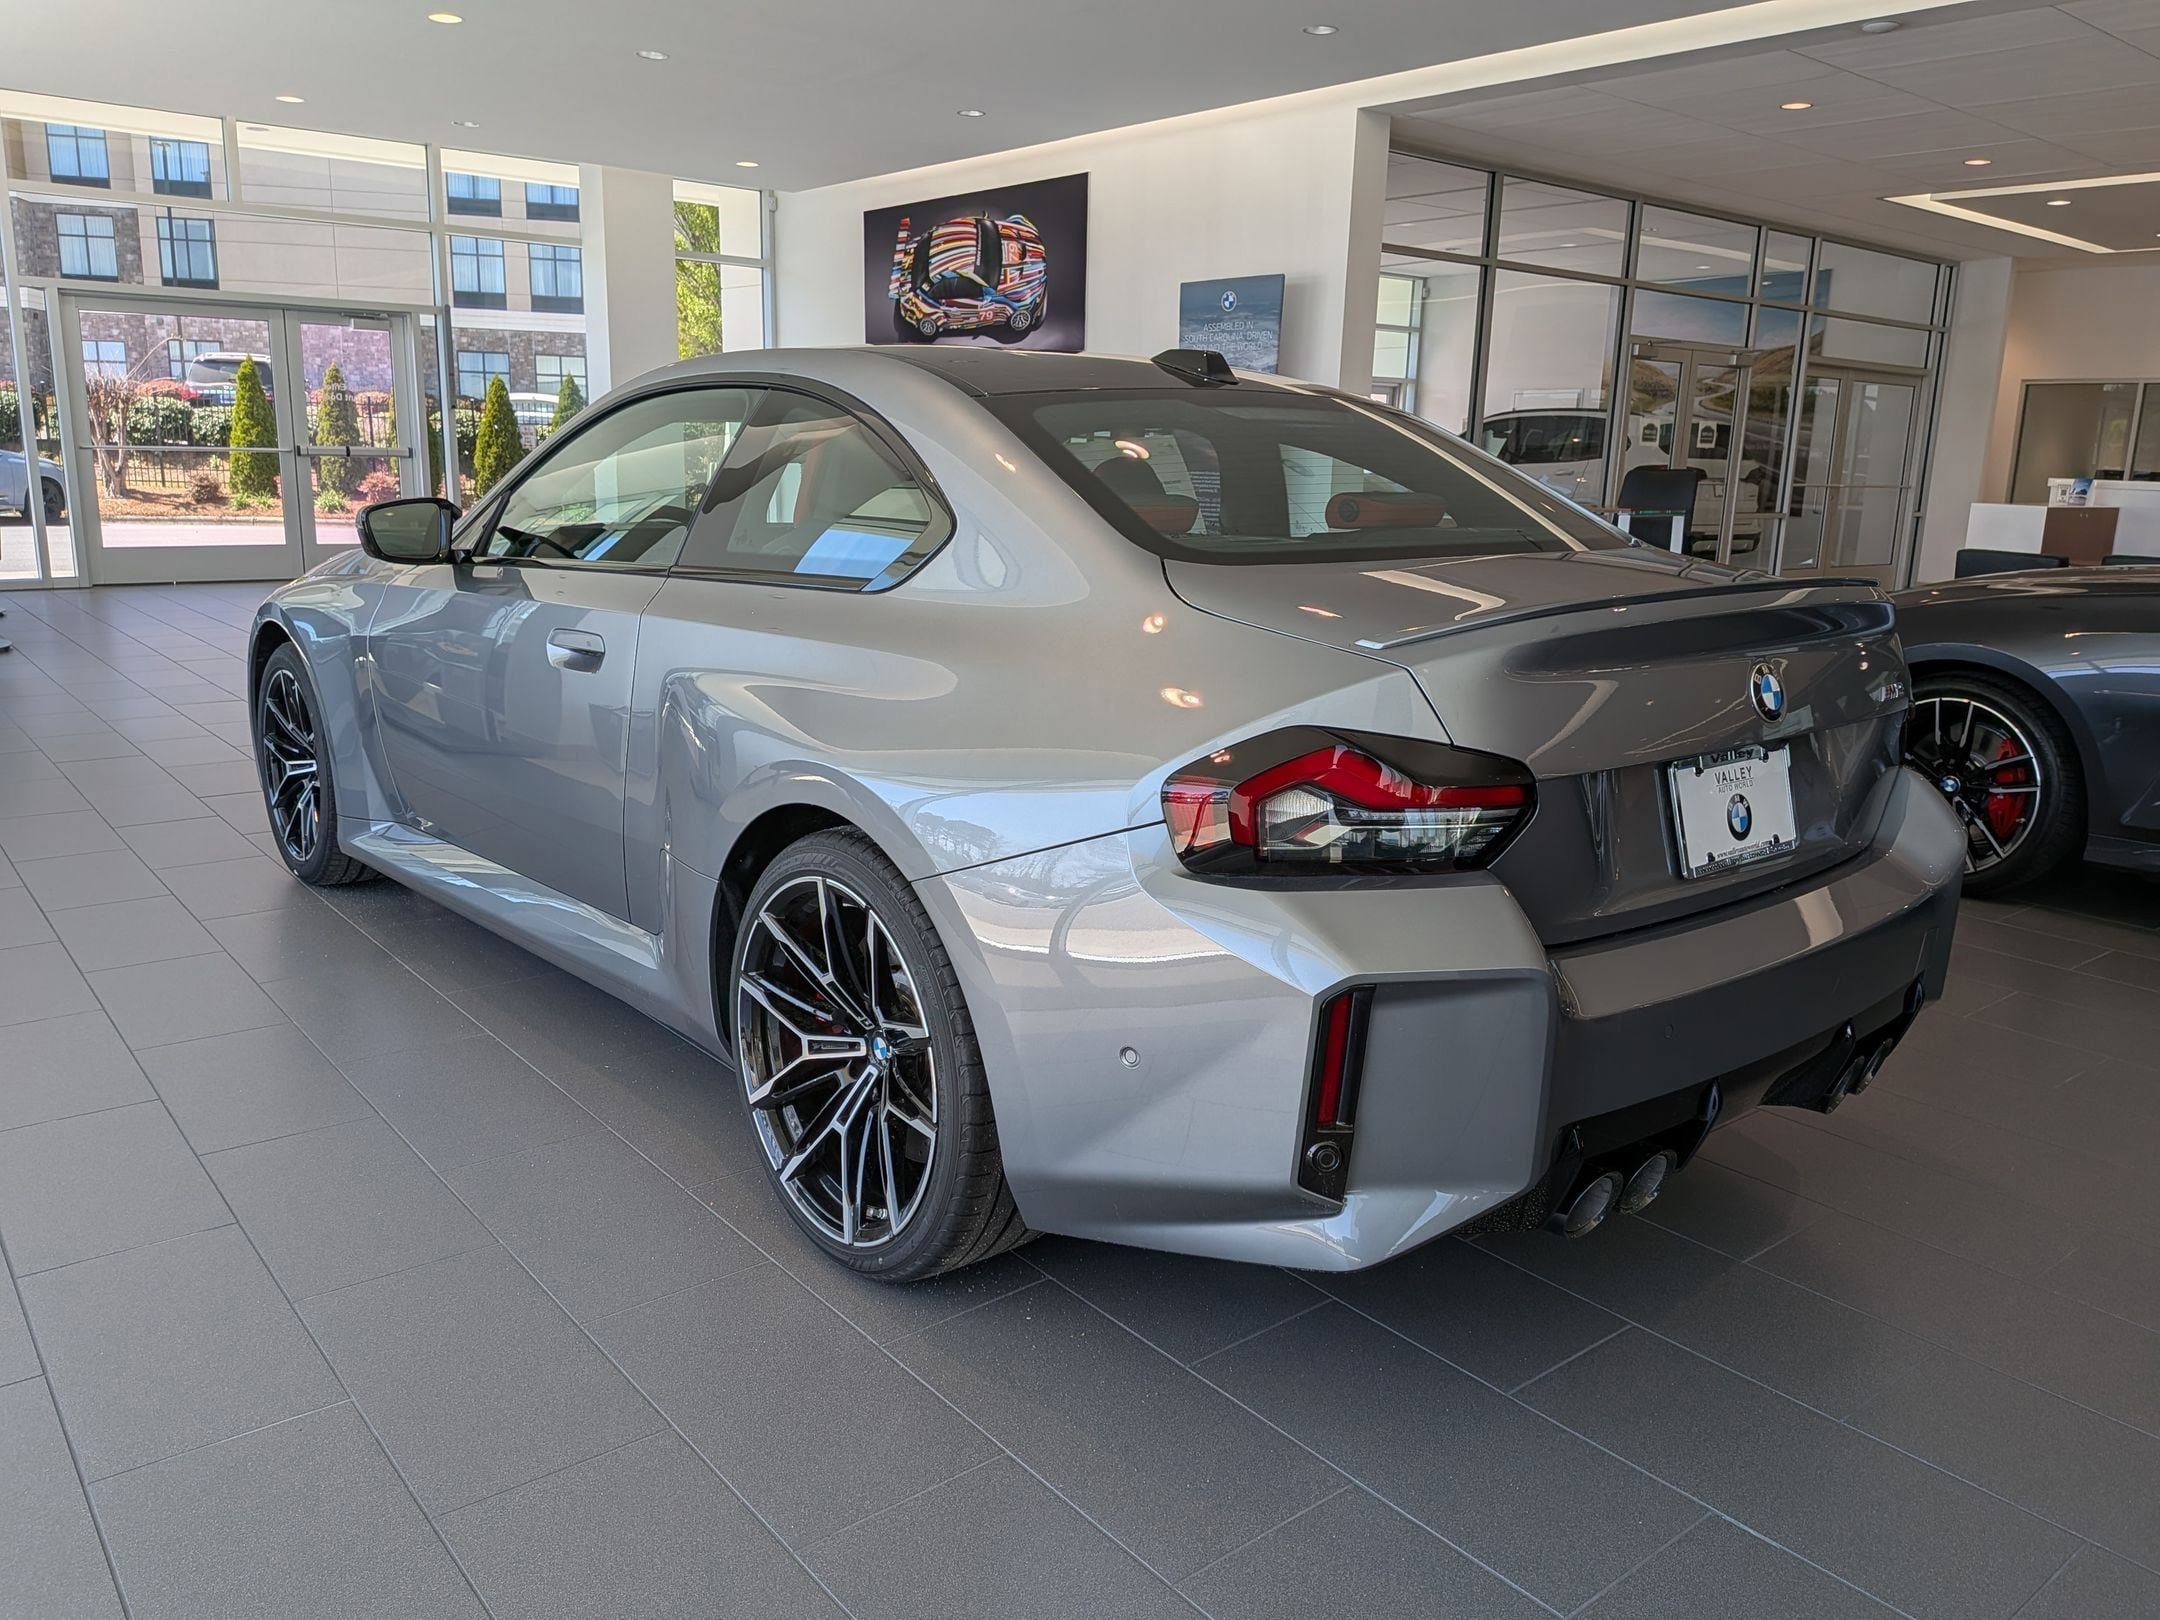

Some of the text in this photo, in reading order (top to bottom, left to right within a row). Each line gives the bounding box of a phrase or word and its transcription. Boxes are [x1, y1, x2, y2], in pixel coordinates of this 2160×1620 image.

[979, 310, 994, 321] 79
[1203, 322, 1244, 332] ASSEMBLED
[1184, 334, 1207, 344] SOUTH
[1246, 331, 1273, 340] DRIVEN
[1222, 343, 1237, 352] THE
[1711, 748, 1755, 763] Valley
[1714, 766, 1752, 784] VALLEY
[1718, 780, 1754, 794] AUTO WORLD
